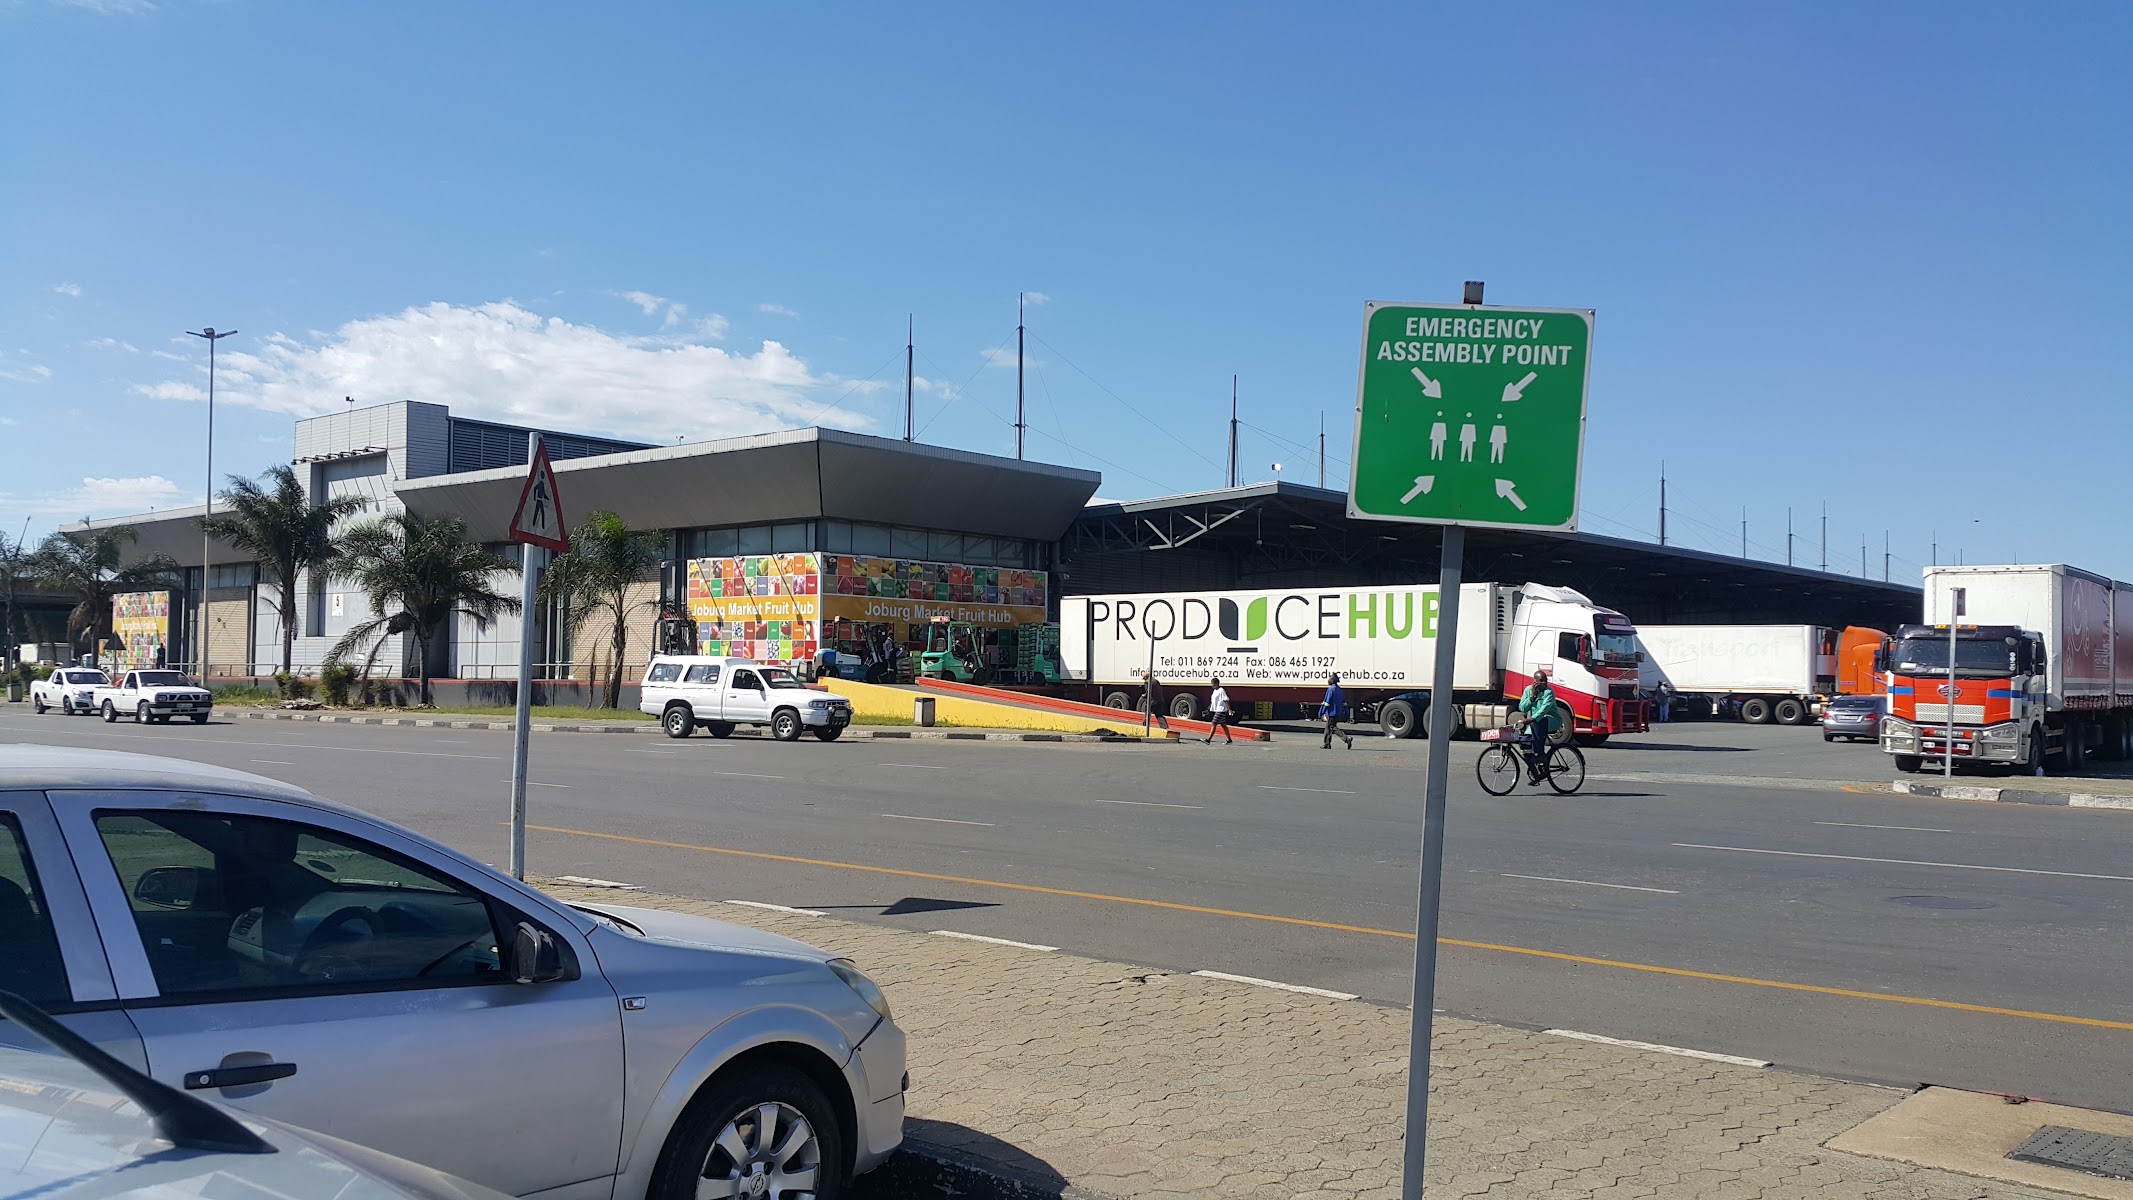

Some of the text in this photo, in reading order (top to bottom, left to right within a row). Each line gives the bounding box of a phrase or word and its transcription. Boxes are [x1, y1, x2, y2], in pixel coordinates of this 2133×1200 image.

[1406, 317, 1544, 339] EMERGENCY
[1377, 341, 1573, 366] ASSEMBLY POINT
[692, 599, 814, 618] Joburg Market Fruit Hub
[865, 601, 1011, 623] Joburg Market Fruit Hub
[1160, 656, 1335, 667] Tel: 011 869 7244 Fax: 086 465 1927
[1246, 668, 1271, 679] Web:
